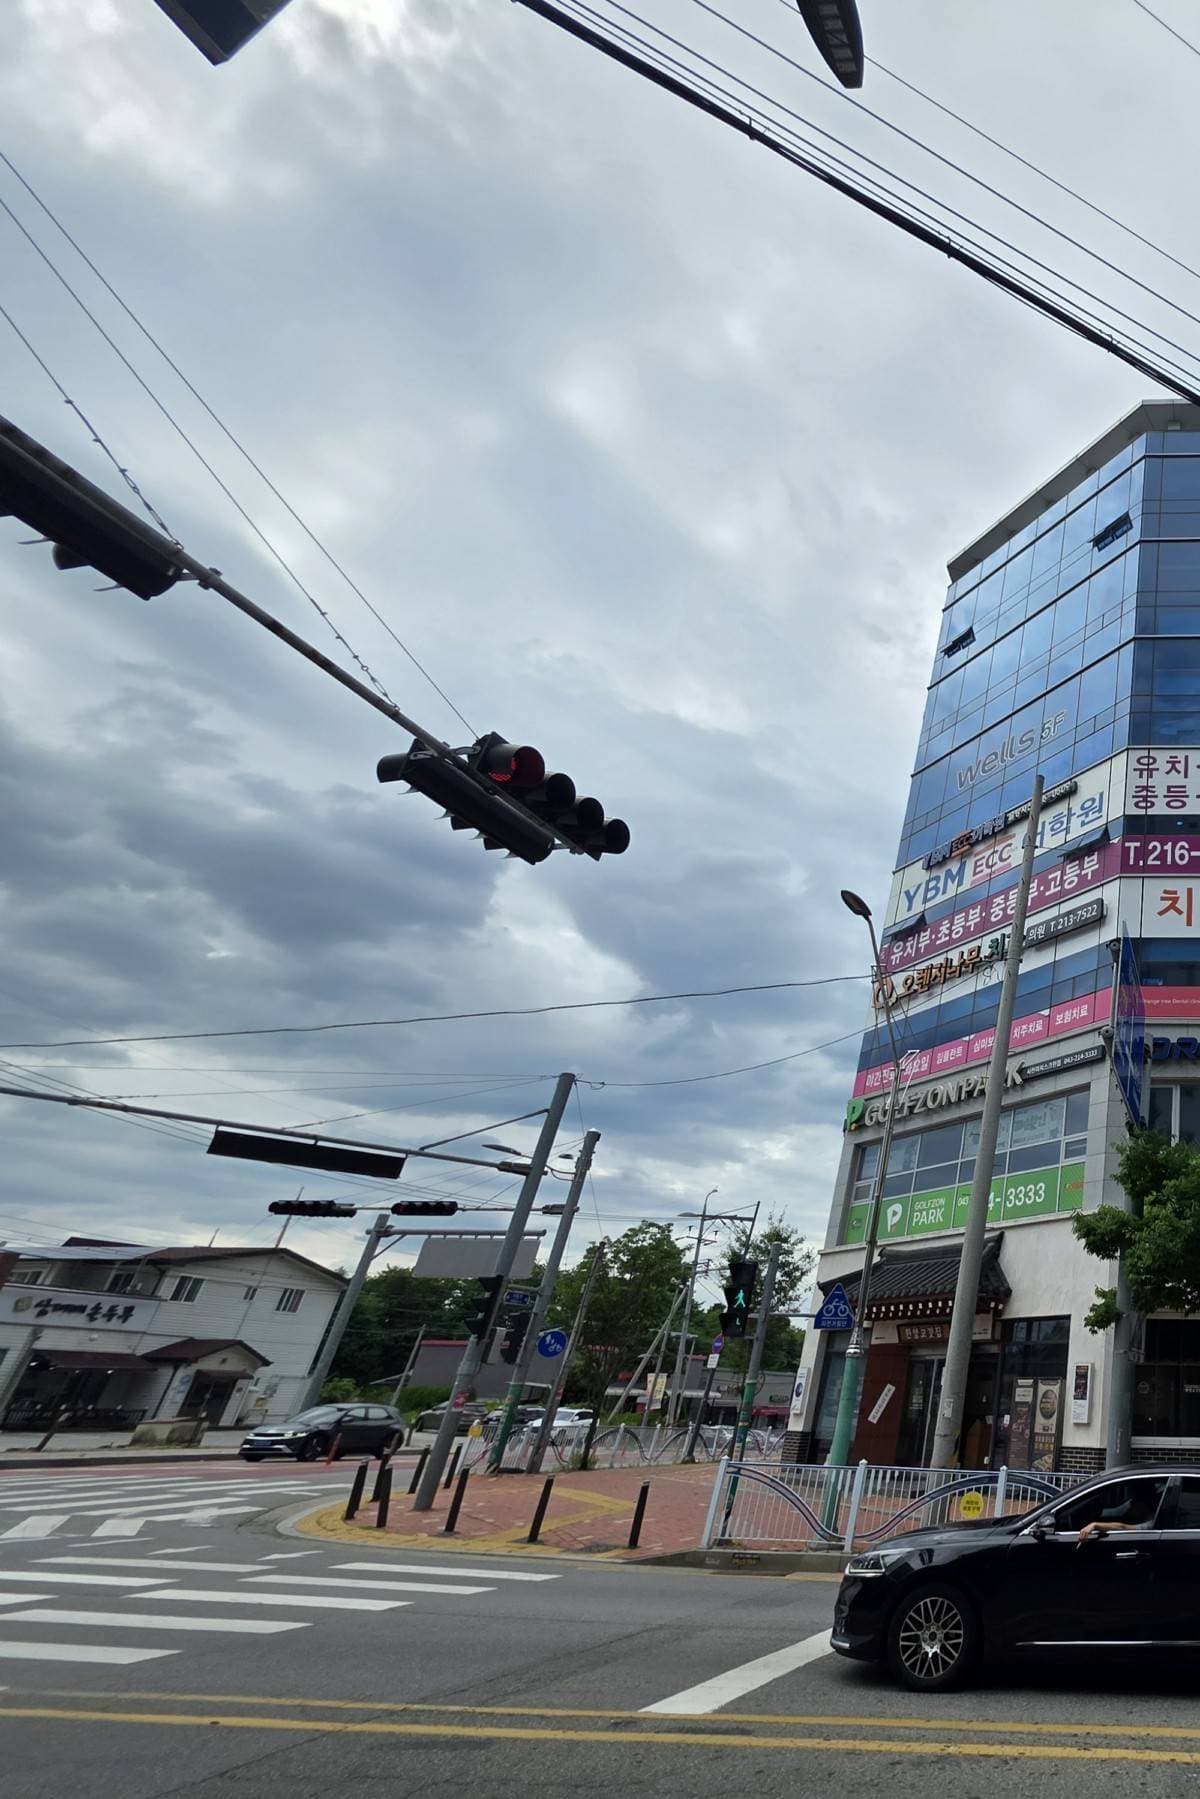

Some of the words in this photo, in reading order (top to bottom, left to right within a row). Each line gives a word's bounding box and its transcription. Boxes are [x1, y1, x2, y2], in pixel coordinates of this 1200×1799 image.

[957, 729, 1035, 790] wells
[904, 861, 967, 912] YBM
[972, 842, 1014, 877] ECC
[1055, 1003, 1089, 1025] 보험치료
[973, 1035, 995, 1053] 심미보
[865, 1059, 1025, 1126] GOLFZONPAK
[915, 1198, 945, 1210] GOLFZON
[912, 1208, 944, 1226] PARK
